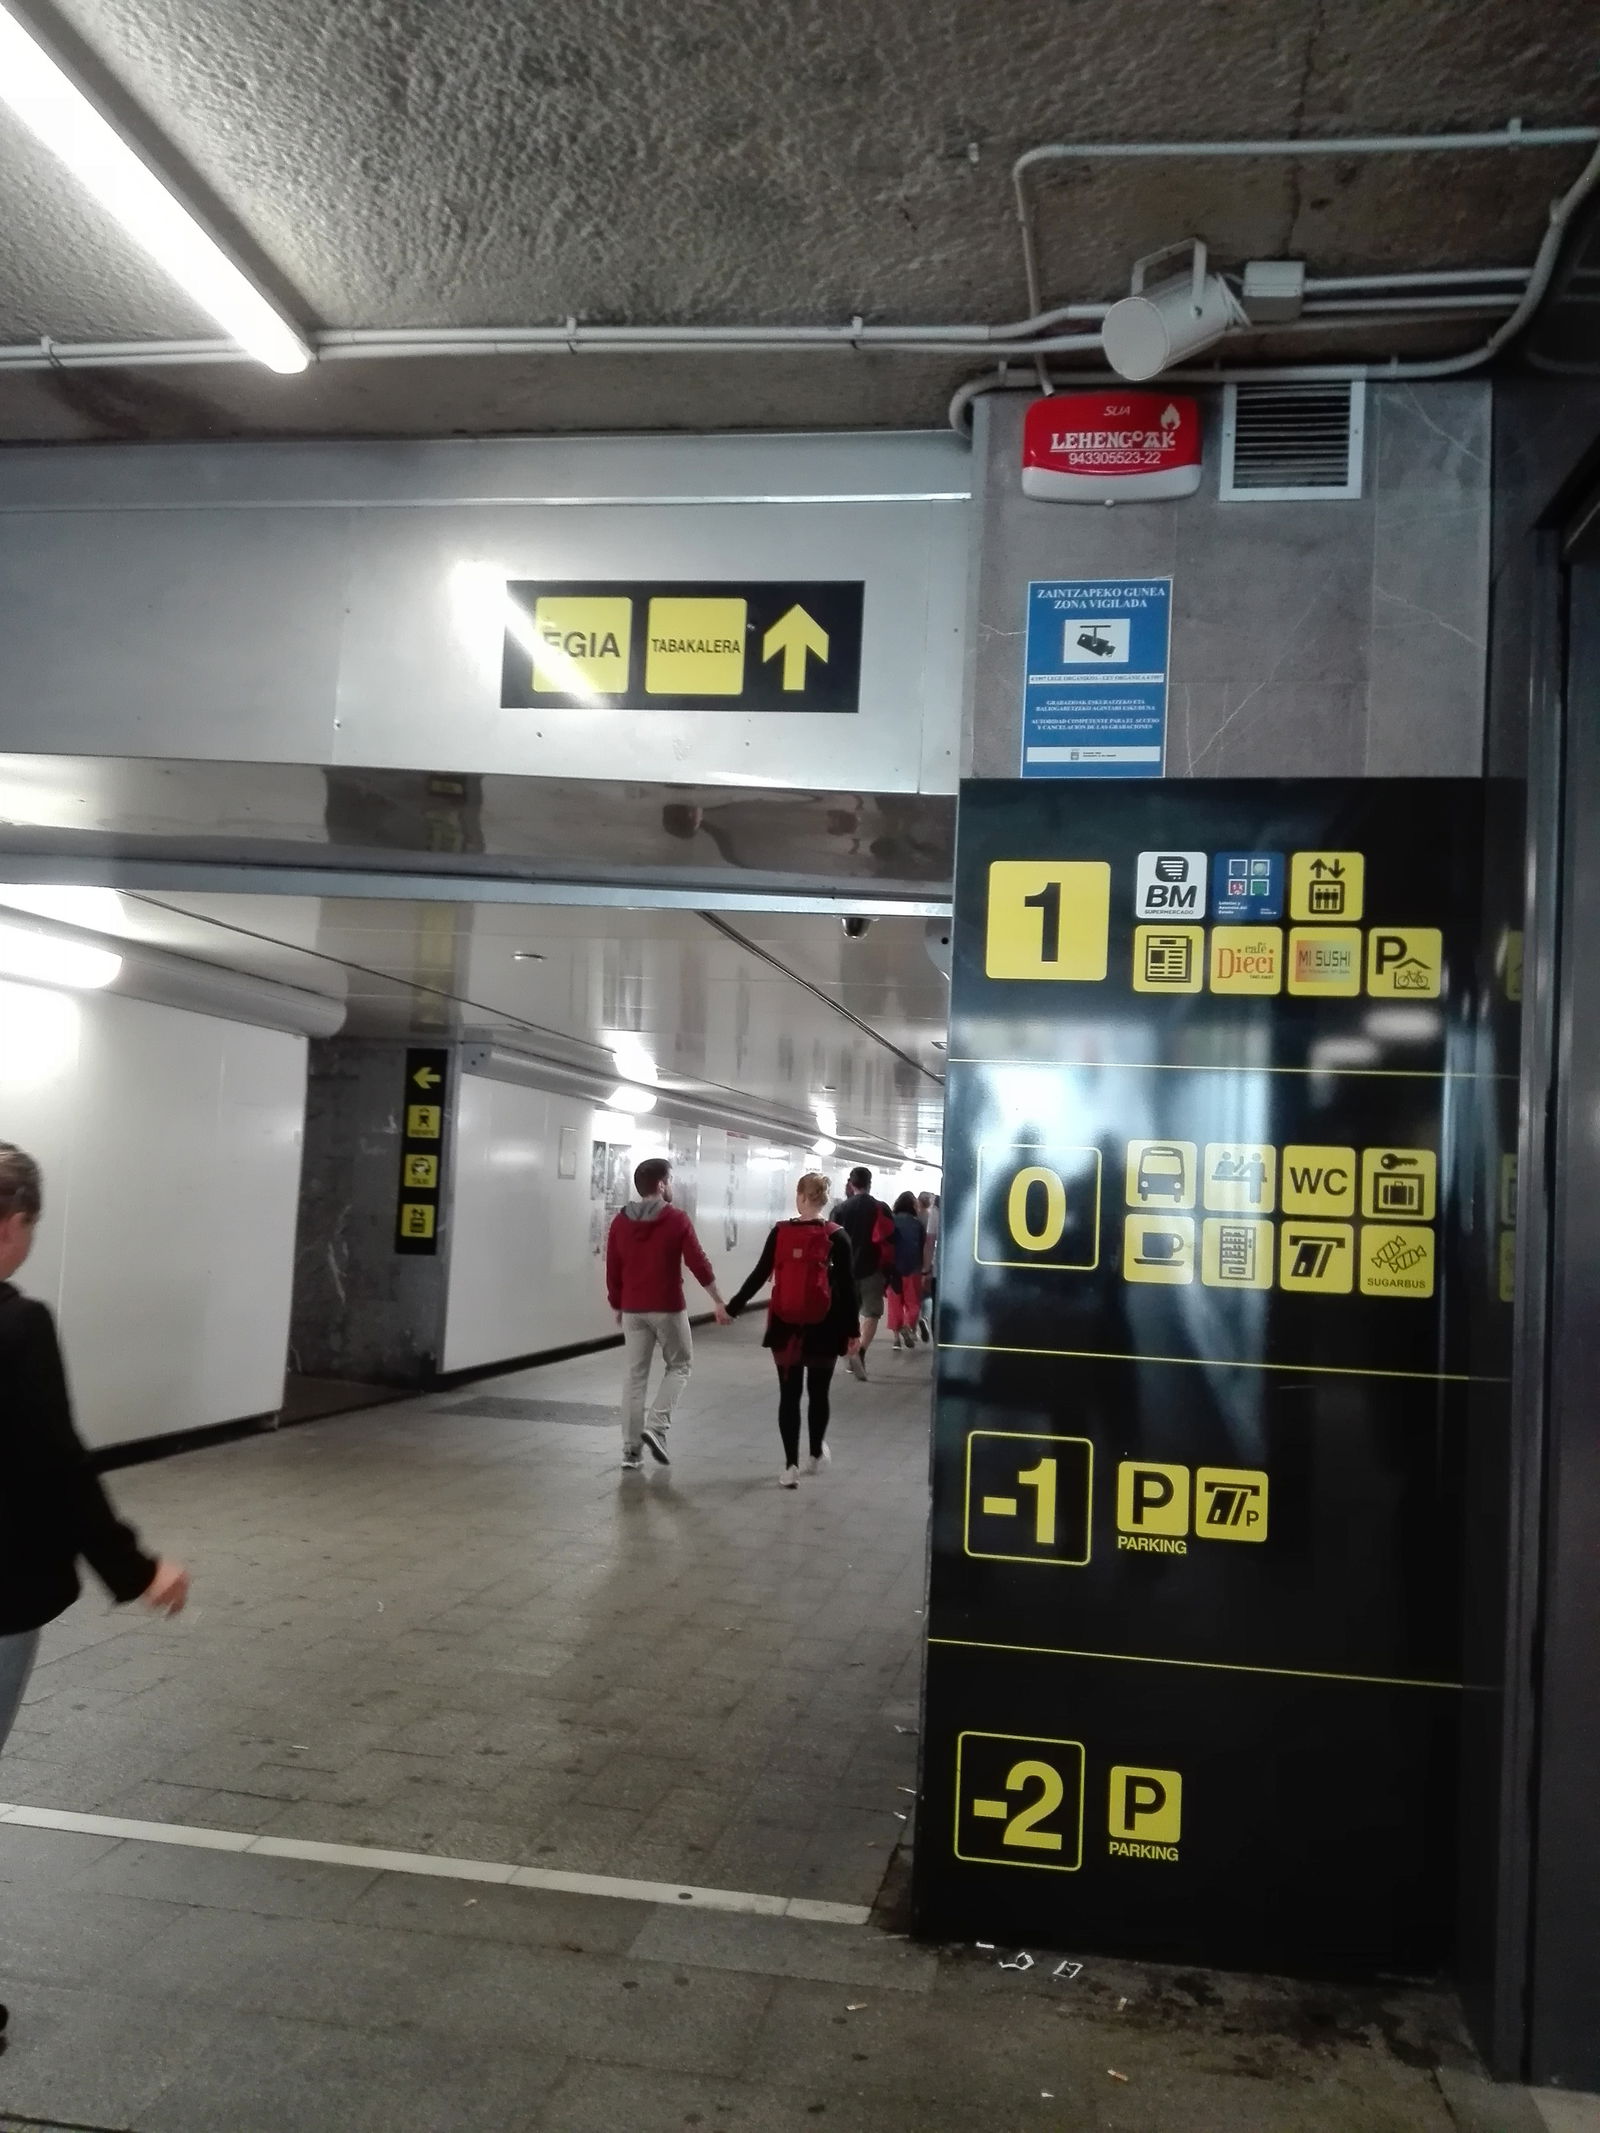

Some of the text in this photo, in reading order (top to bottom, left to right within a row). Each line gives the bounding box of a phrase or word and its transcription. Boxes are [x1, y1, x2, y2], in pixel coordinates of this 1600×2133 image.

[1068, 451, 1161, 465] 943305523-22
[1037, 587, 1165, 598] ZAINTZAPEKO GUNEA
[1054, 598, 1148, 609] ZONA VIGILADA
[651, 638, 741, 654] TABAKALERA
[1145, 884, 1198, 908] BM
[1024, 881, 1062, 963] 1
[1245, 942, 1267, 954] café
[1298, 950, 1351, 967] MI SUSHI
[1376, 935, 1407, 975] P
[1217, 948, 1275, 979] Dieci
[1289, 1166, 1348, 1196] WC
[1008, 1166, 1066, 1251] 0
[1367, 1277, 1426, 1289] SUGARBUS
[982, 1457, 1057, 1544] -1
[1132, 1469, 1175, 1525] P
[1246, 1509, 1259, 1527] P
[1117, 1535, 1187, 1555] PARKING
[973, 1760, 1064, 1850] -2
[1124, 1774, 1167, 1831] P
[1108, 1841, 1179, 1862] PARKING
